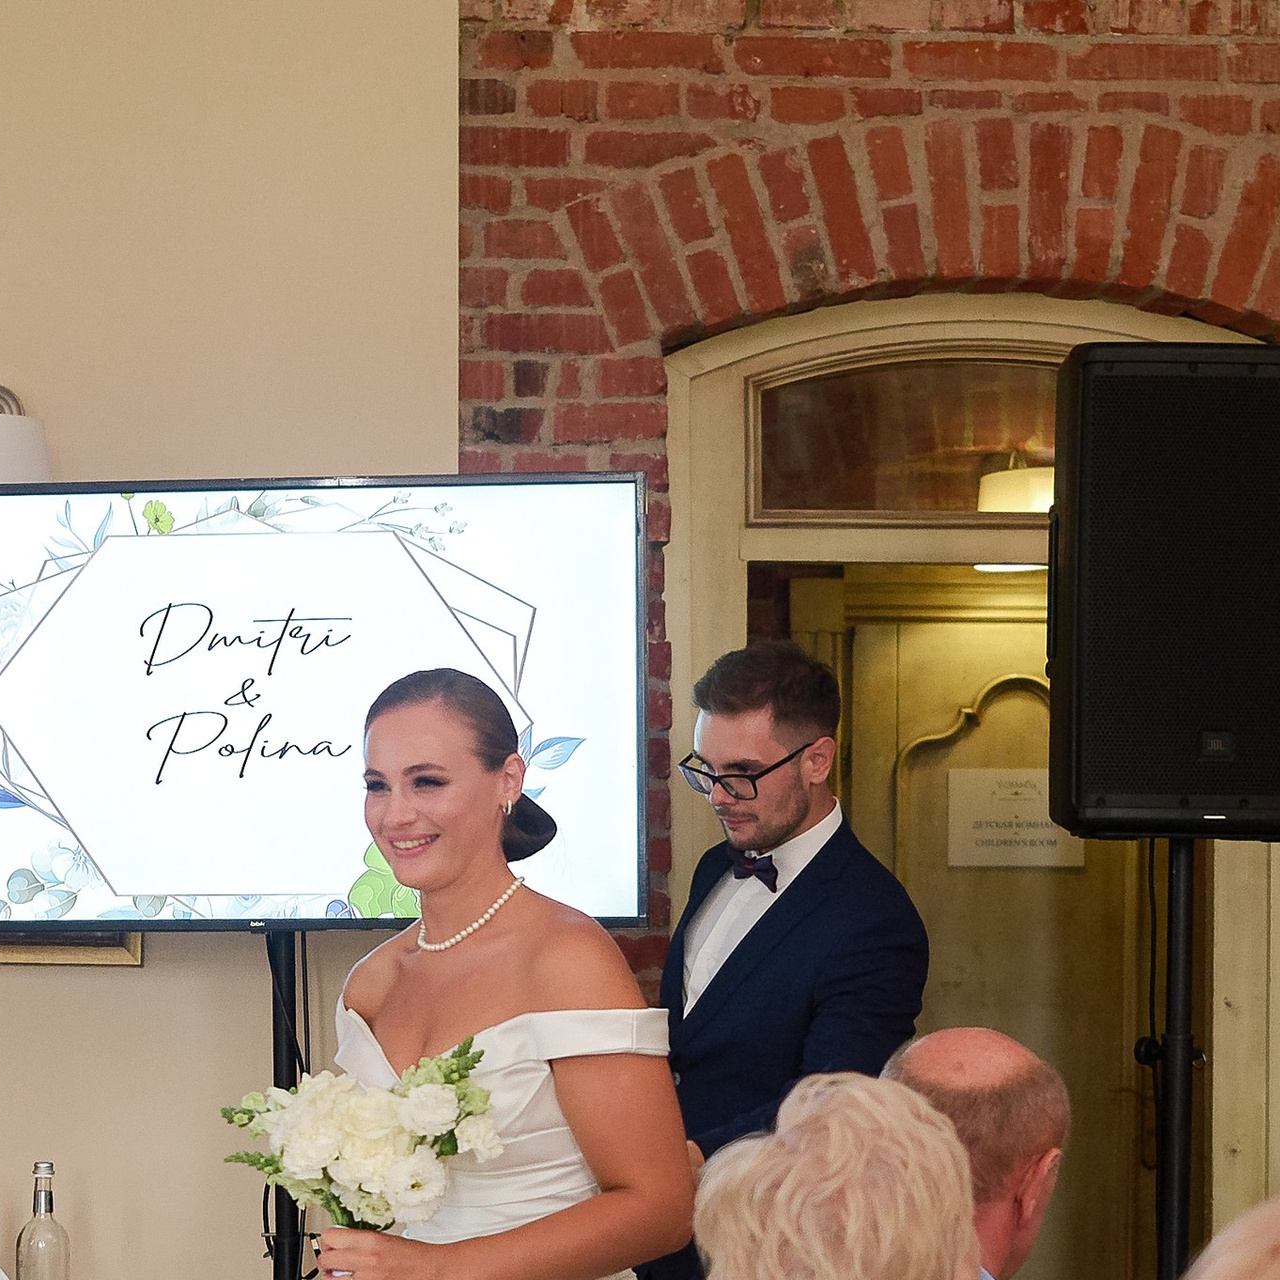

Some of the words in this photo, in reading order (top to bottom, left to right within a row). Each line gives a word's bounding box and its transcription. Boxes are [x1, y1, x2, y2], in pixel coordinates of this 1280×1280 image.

[140, 603, 352, 676] Dmitri
[224, 678, 261, 707] &
[147, 712, 352, 785] Polina
[1207, 739, 1225, 750] JBL
